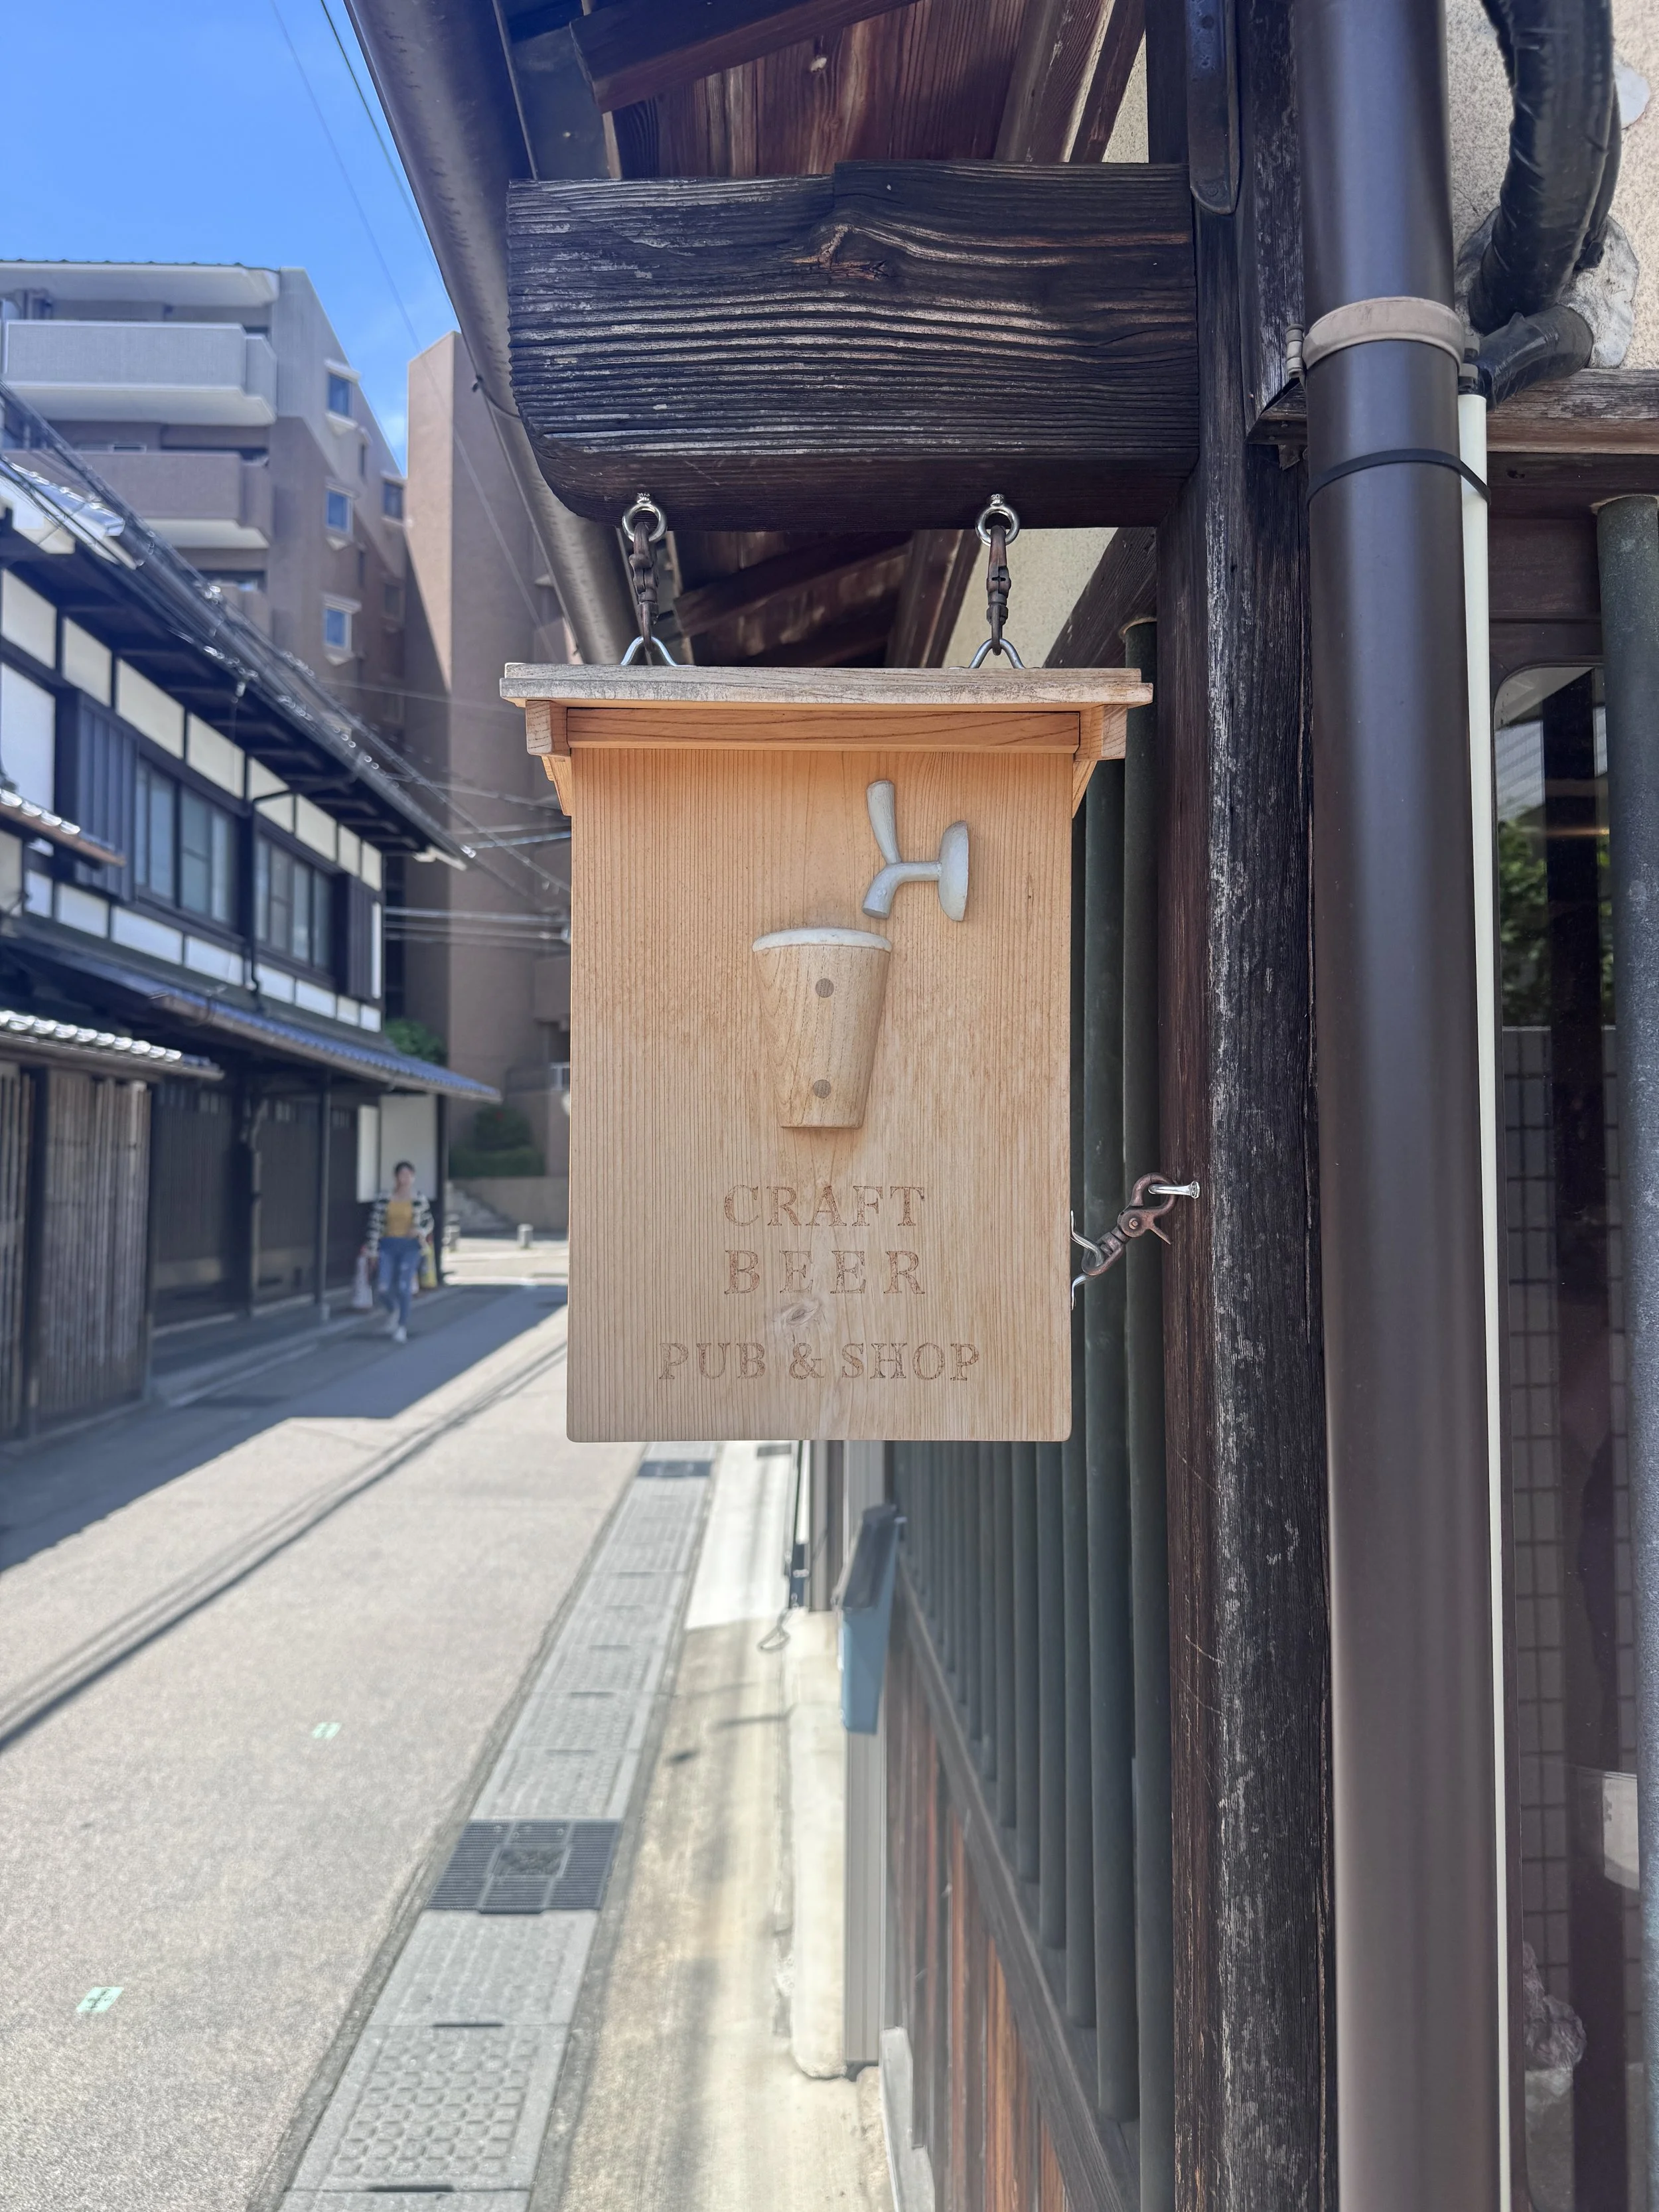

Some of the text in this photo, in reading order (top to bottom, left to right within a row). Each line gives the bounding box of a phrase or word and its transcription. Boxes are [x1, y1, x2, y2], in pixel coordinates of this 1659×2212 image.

[724, 1185, 925, 1227] CRAFT
[724, 1250, 926, 1294] BEER
[659, 1342, 980, 1381] PUB & SHOP
